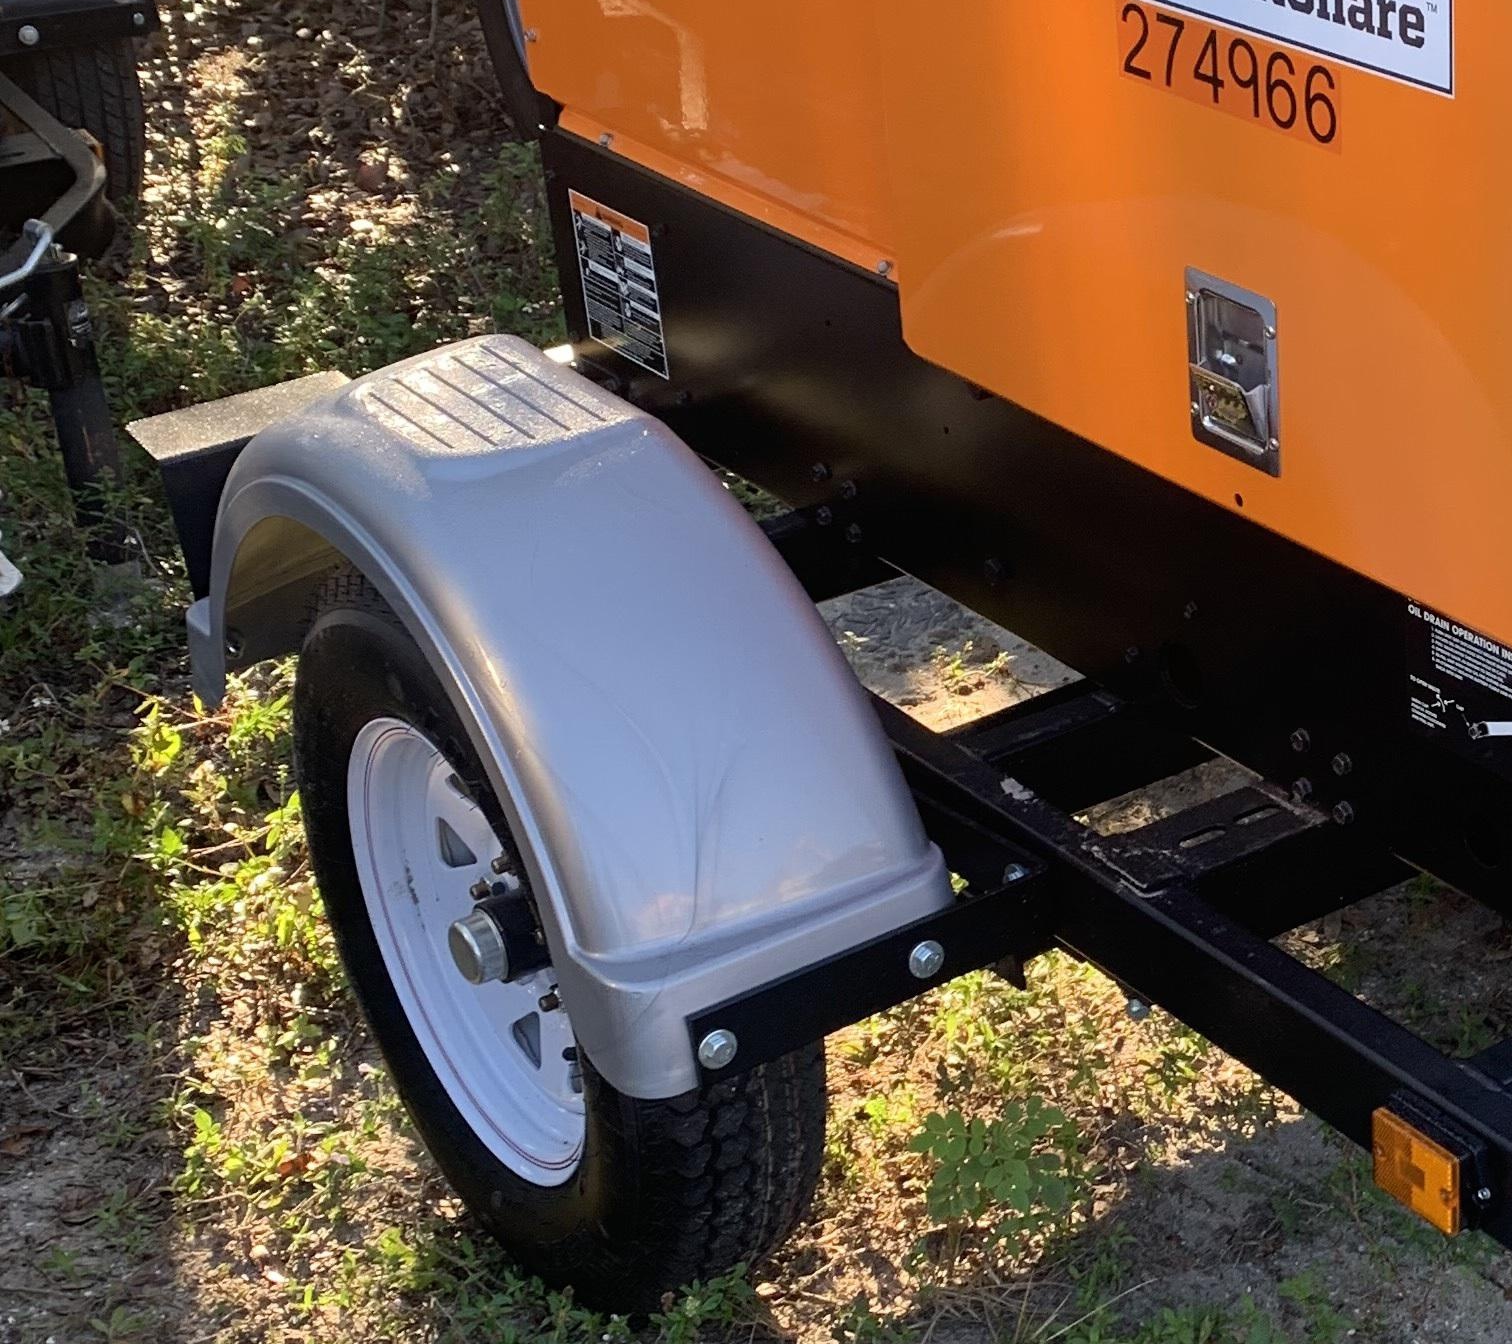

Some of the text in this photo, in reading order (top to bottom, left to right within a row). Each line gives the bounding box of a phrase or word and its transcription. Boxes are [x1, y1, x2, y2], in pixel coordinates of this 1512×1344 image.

[1119, 2, 1339, 146] 274966
[1407, 604, 1423, 619] OIL
[1423, 611, 1450, 632] DRAIN
[1451, 625, 1501, 655] OPERATION
